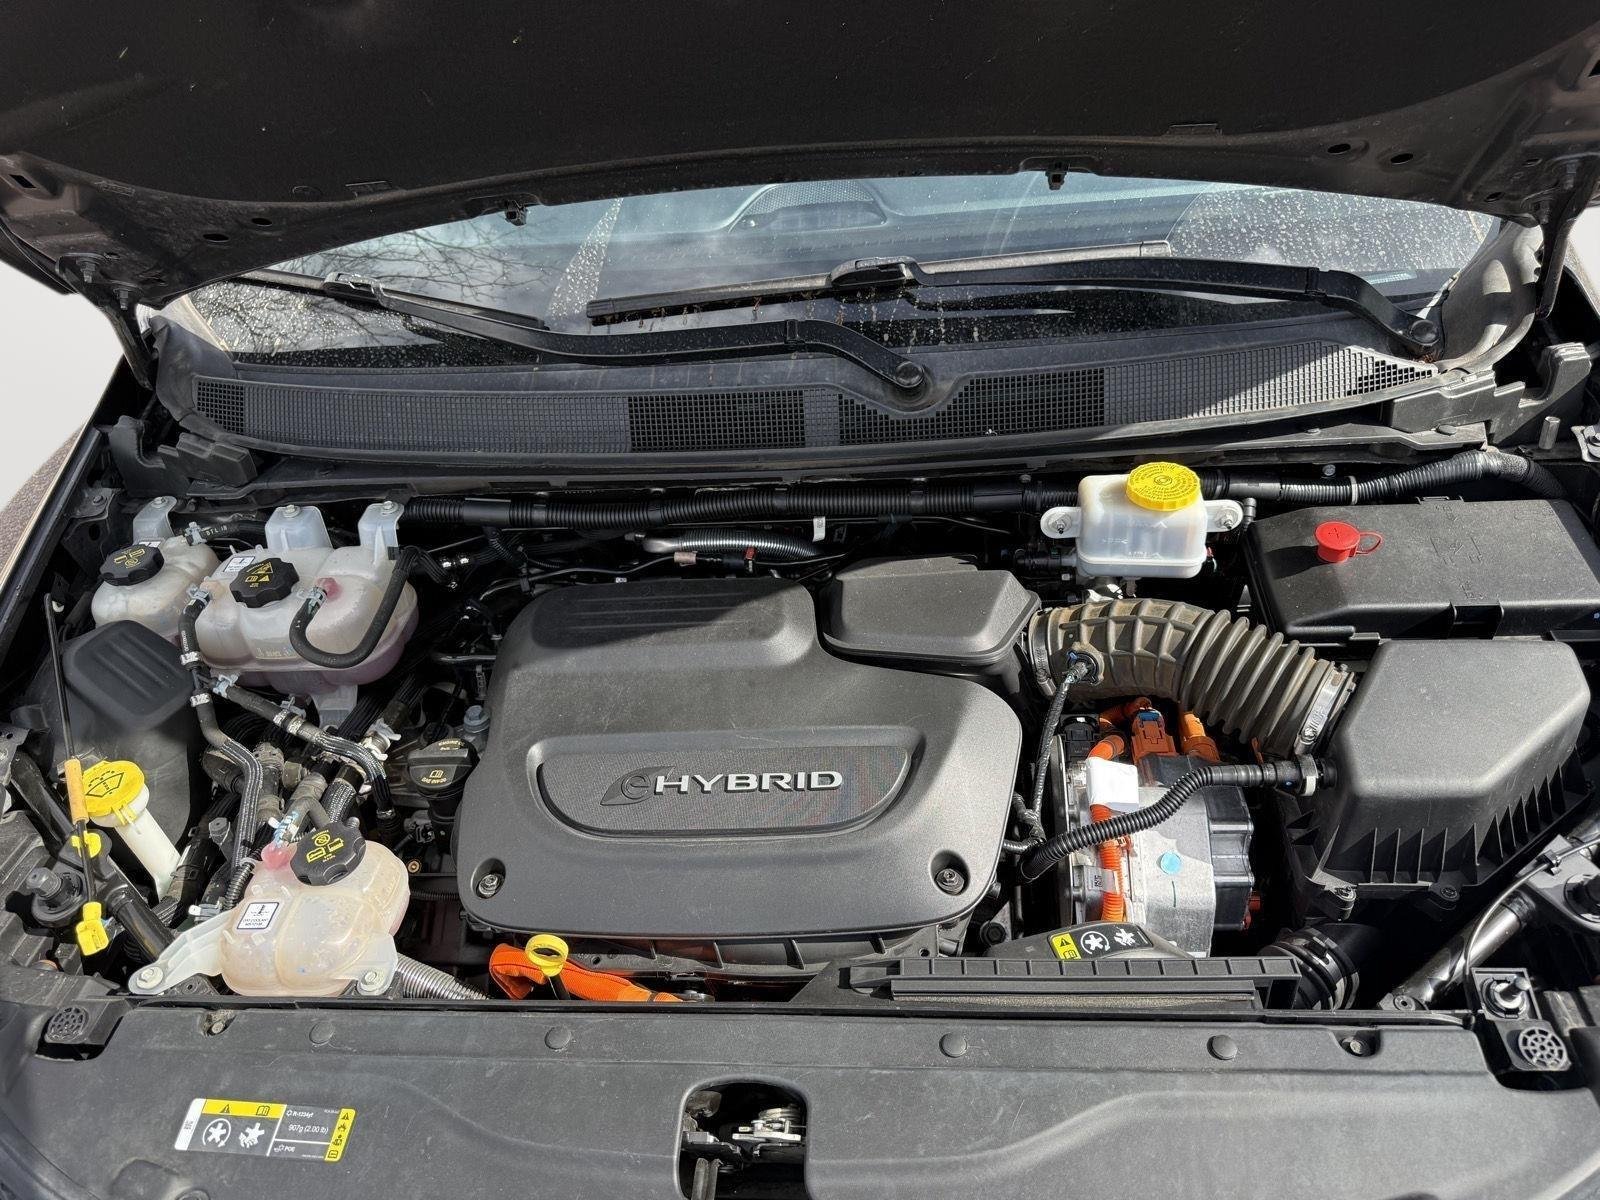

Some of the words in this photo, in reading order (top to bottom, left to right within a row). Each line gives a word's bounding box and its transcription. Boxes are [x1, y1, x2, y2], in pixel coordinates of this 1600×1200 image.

[288, 1124, 303, 1133] 907g
[304, 1125, 320, 1133] (2.00
[320, 1127, 329, 1135] lb)
